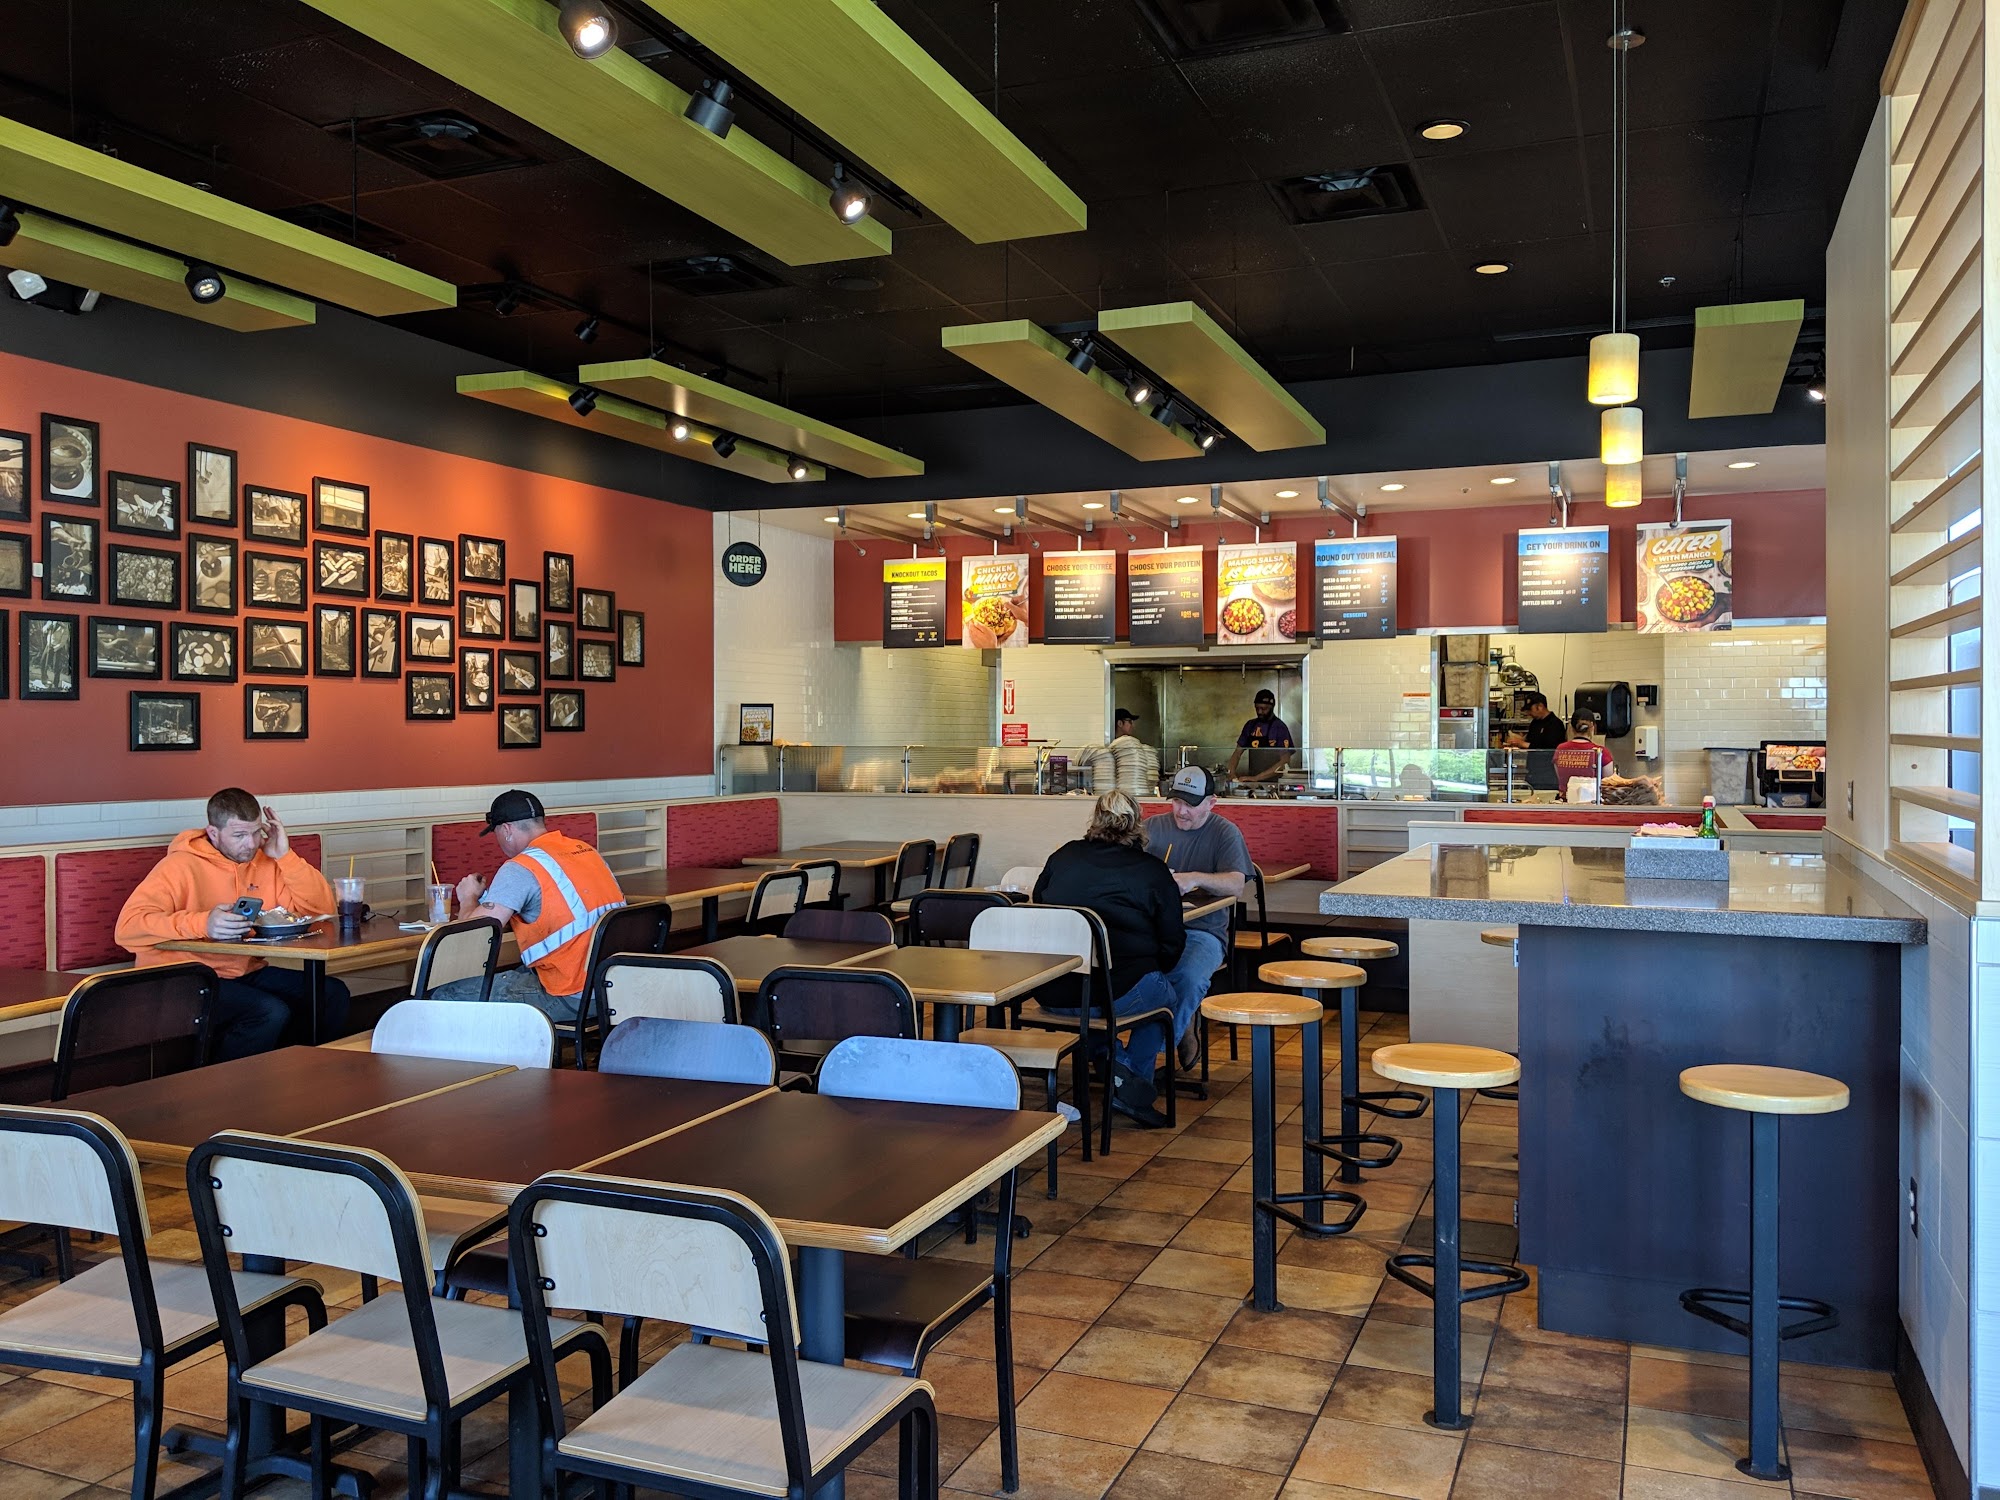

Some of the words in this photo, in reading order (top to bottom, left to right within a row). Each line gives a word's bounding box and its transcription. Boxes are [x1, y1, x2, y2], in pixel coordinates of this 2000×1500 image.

[1565, 541, 1587, 549] DRINK
[1651, 533, 1718, 555] CATER
[728, 554, 761, 565] ORDER
[1316, 554, 1340, 562] ROUND
[1681, 551, 1711, 559] MANGO
[1090, 561, 1113, 570] ENTRÉE
[1130, 563, 1154, 571] CHOOSE
[1156, 561, 1172, 569] YOUR
[1174, 560, 1200, 568] PROTEIN
[1227, 558, 1257, 567] MANGO
[1258, 555, 1284, 564] SALSA
[728, 562, 761, 575] HERE
[891, 570, 920, 578] KNOCKOUT
[977, 564, 1012, 575] CHICKEN
[1225, 567, 1243, 580] IS
[1243, 562, 1288, 578] BACK!
[973, 571, 1017, 584] MANGO
[980, 583, 1007, 591] SALAD
